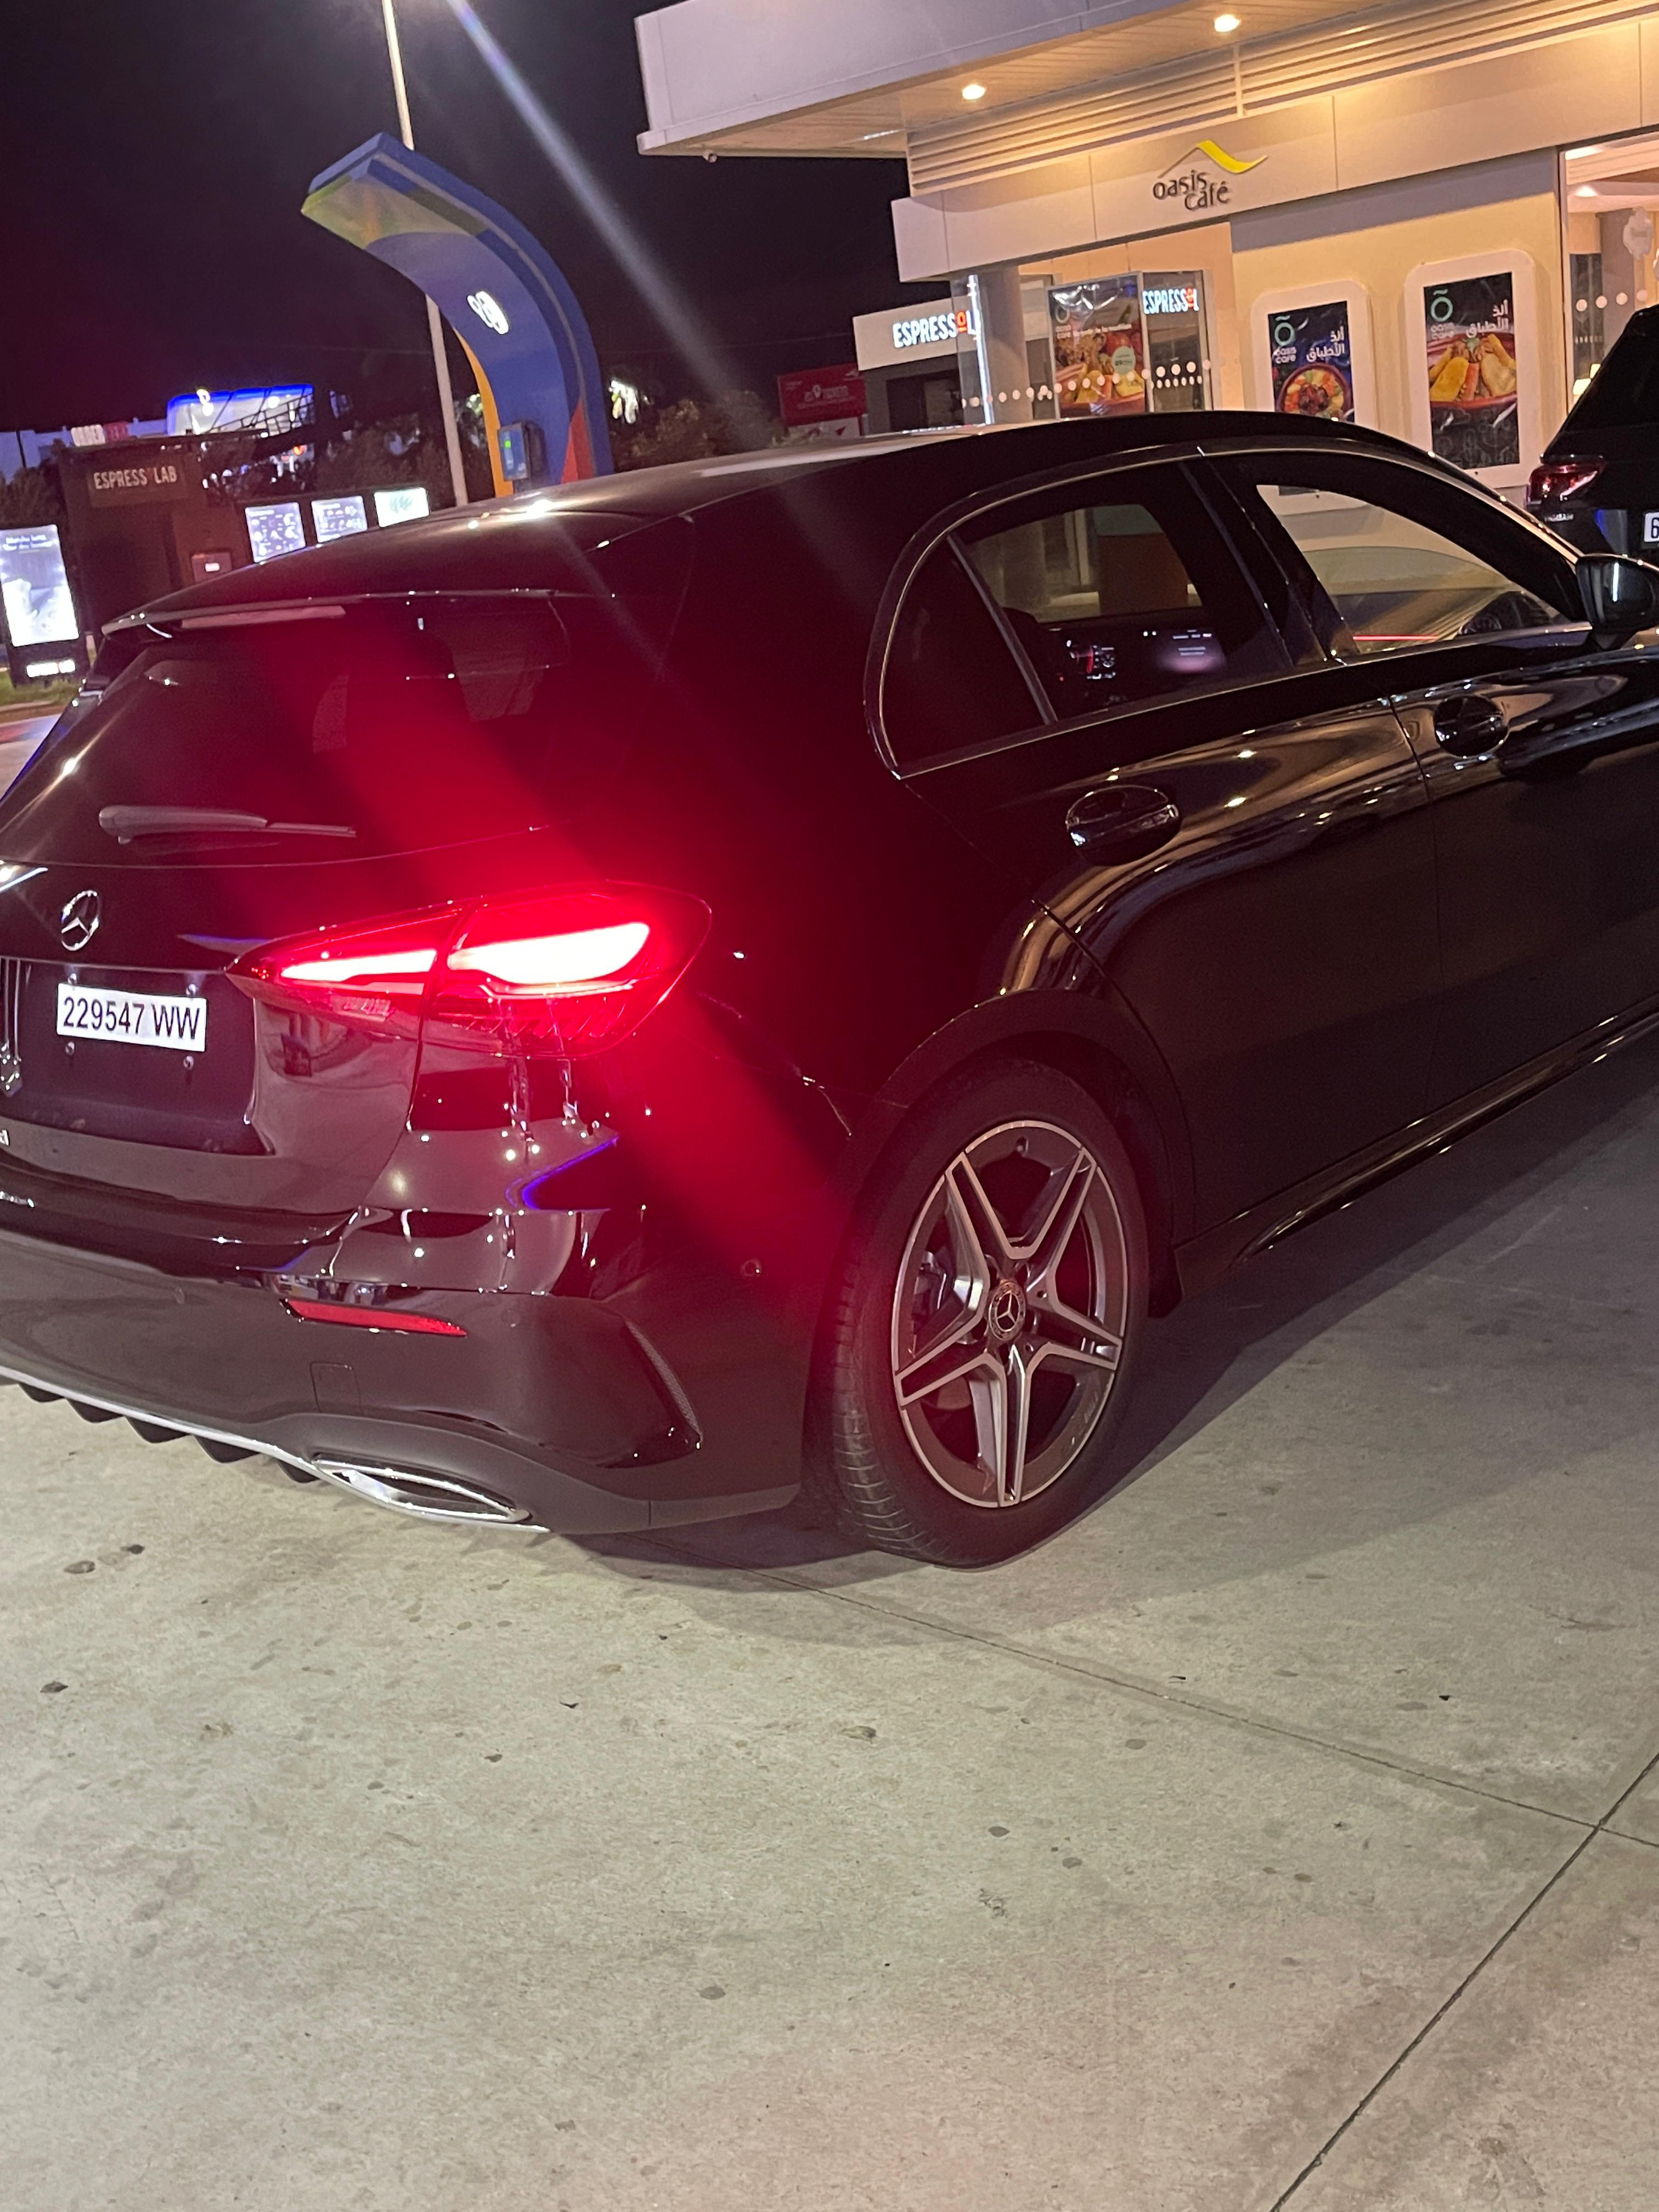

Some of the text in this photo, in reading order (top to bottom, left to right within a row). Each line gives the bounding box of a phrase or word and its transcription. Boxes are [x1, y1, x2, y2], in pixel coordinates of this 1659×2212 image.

[1153, 170, 1209, 200] oasis
[893, 310, 980, 348] ESPRESSOL
[63, 997, 200, 1040] 229547 WW
